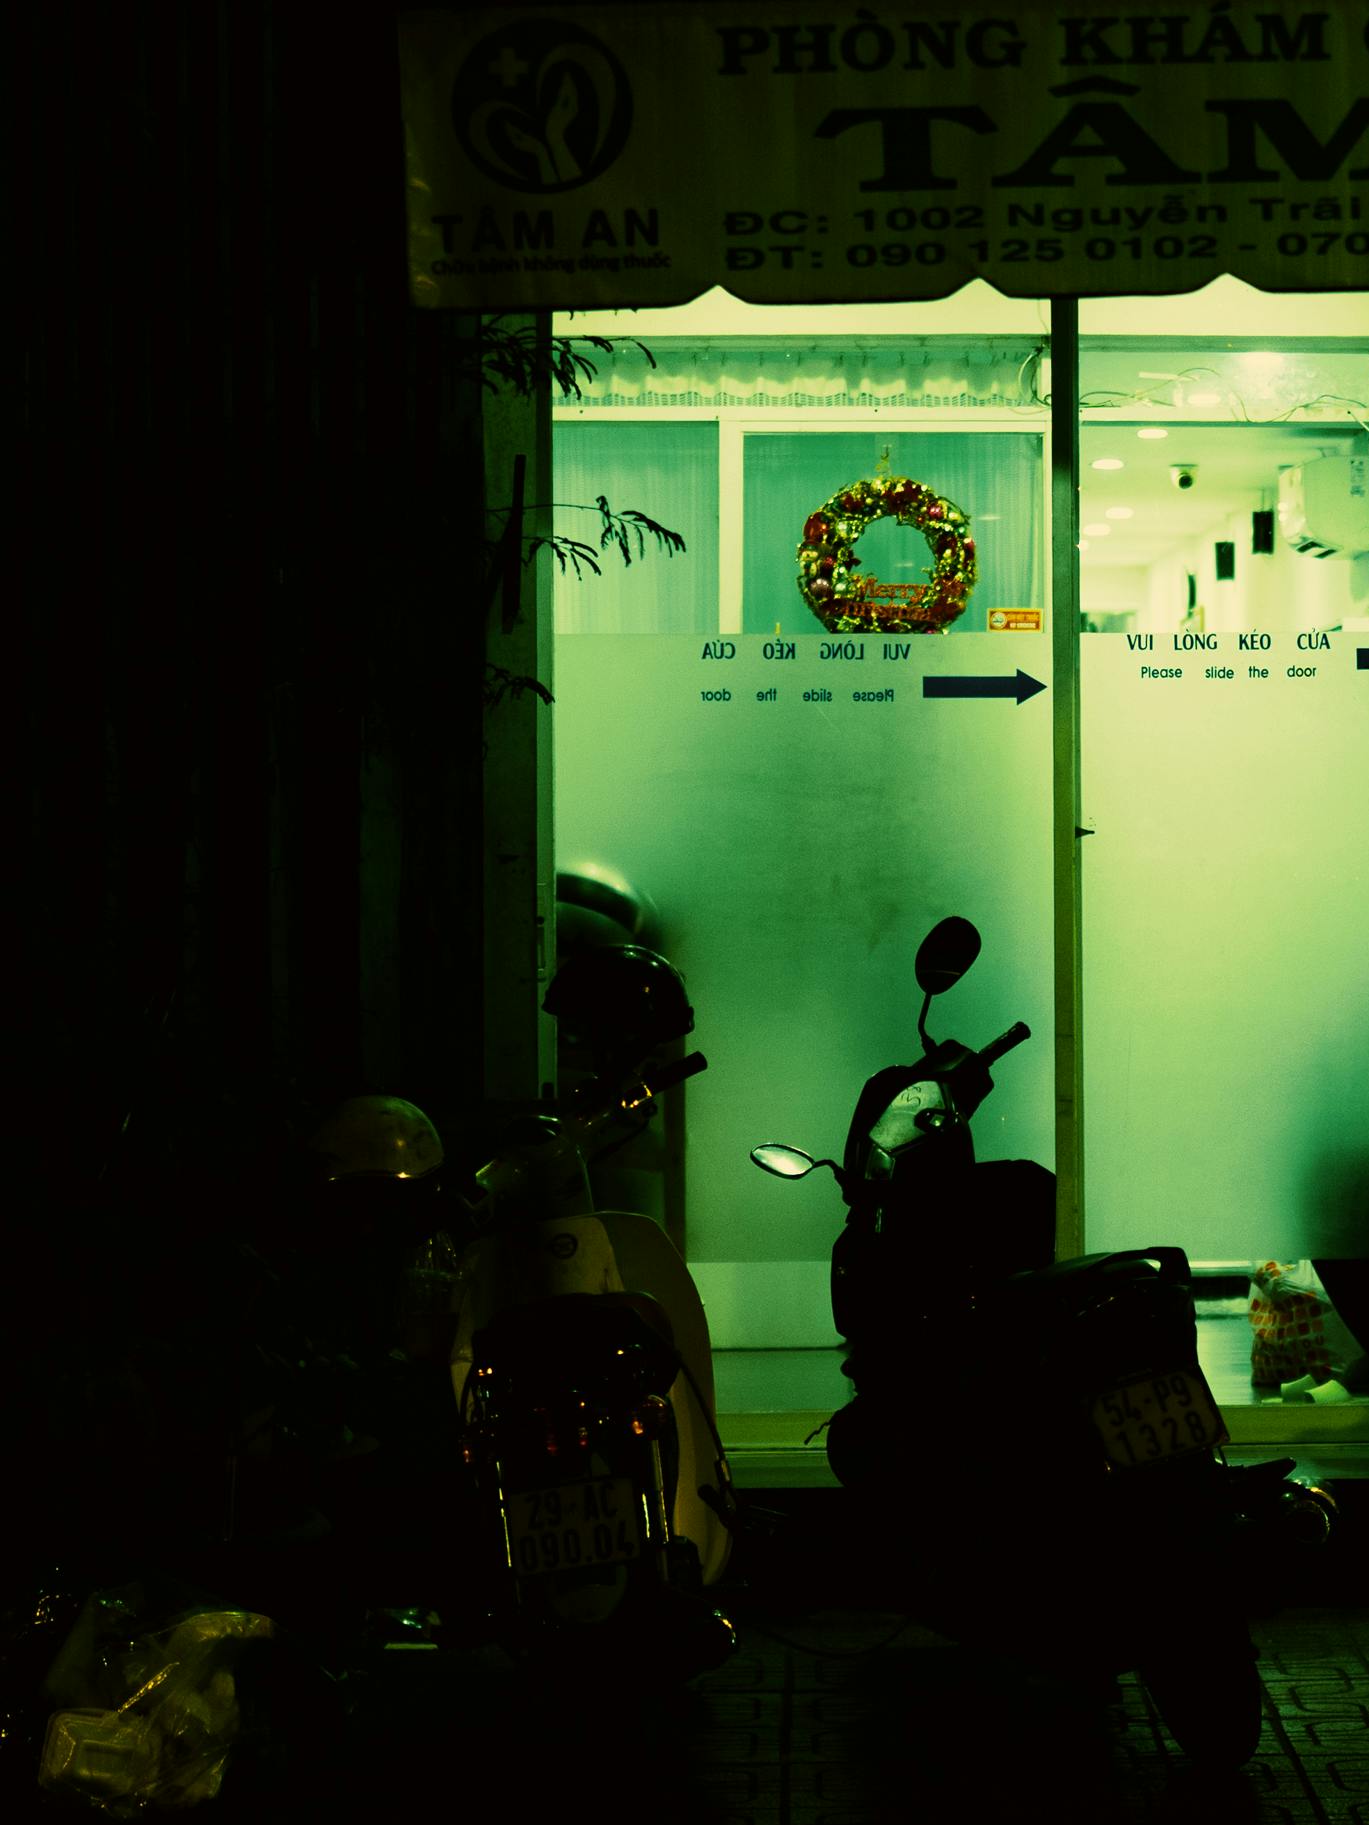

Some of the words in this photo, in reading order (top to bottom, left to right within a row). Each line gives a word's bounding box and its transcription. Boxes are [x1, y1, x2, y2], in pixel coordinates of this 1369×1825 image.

[716, 9, 1027, 76] PHÒNG
[1059, 2, 1331, 65] KHÁM
[431, 204, 555, 253] TÂM
[582, 208, 659, 247] AN
[724, 210, 829, 237] ĐC:
[855, 206, 984, 231] 1002
[1009, 193, 1227, 232] Nguyễn
[1250, 197, 1361, 222] Trãi
[724, 246, 824, 271] ĐT:
[847, 241, 946, 269] 090
[969, 239, 1065, 265] 125
[1086, 233, 1219, 261] 0102
[1127, 632, 1154, 651] VUI
[1173, 629, 1218, 651] LÒNG
[1238, 629, 1271, 651] KÉO
[1296, 628, 1331, 651] CỬA
[1140, 665, 1183, 679] Please
[1205, 666, 1235, 679] slide
[1248, 666, 1270, 678] the
[1286, 665, 1317, 678] door
[1101, 1376, 1191, 1425] 54-P9
[1118, 1411, 1206, 1463] 1328
[519, 1521, 635, 1570] 090.04
